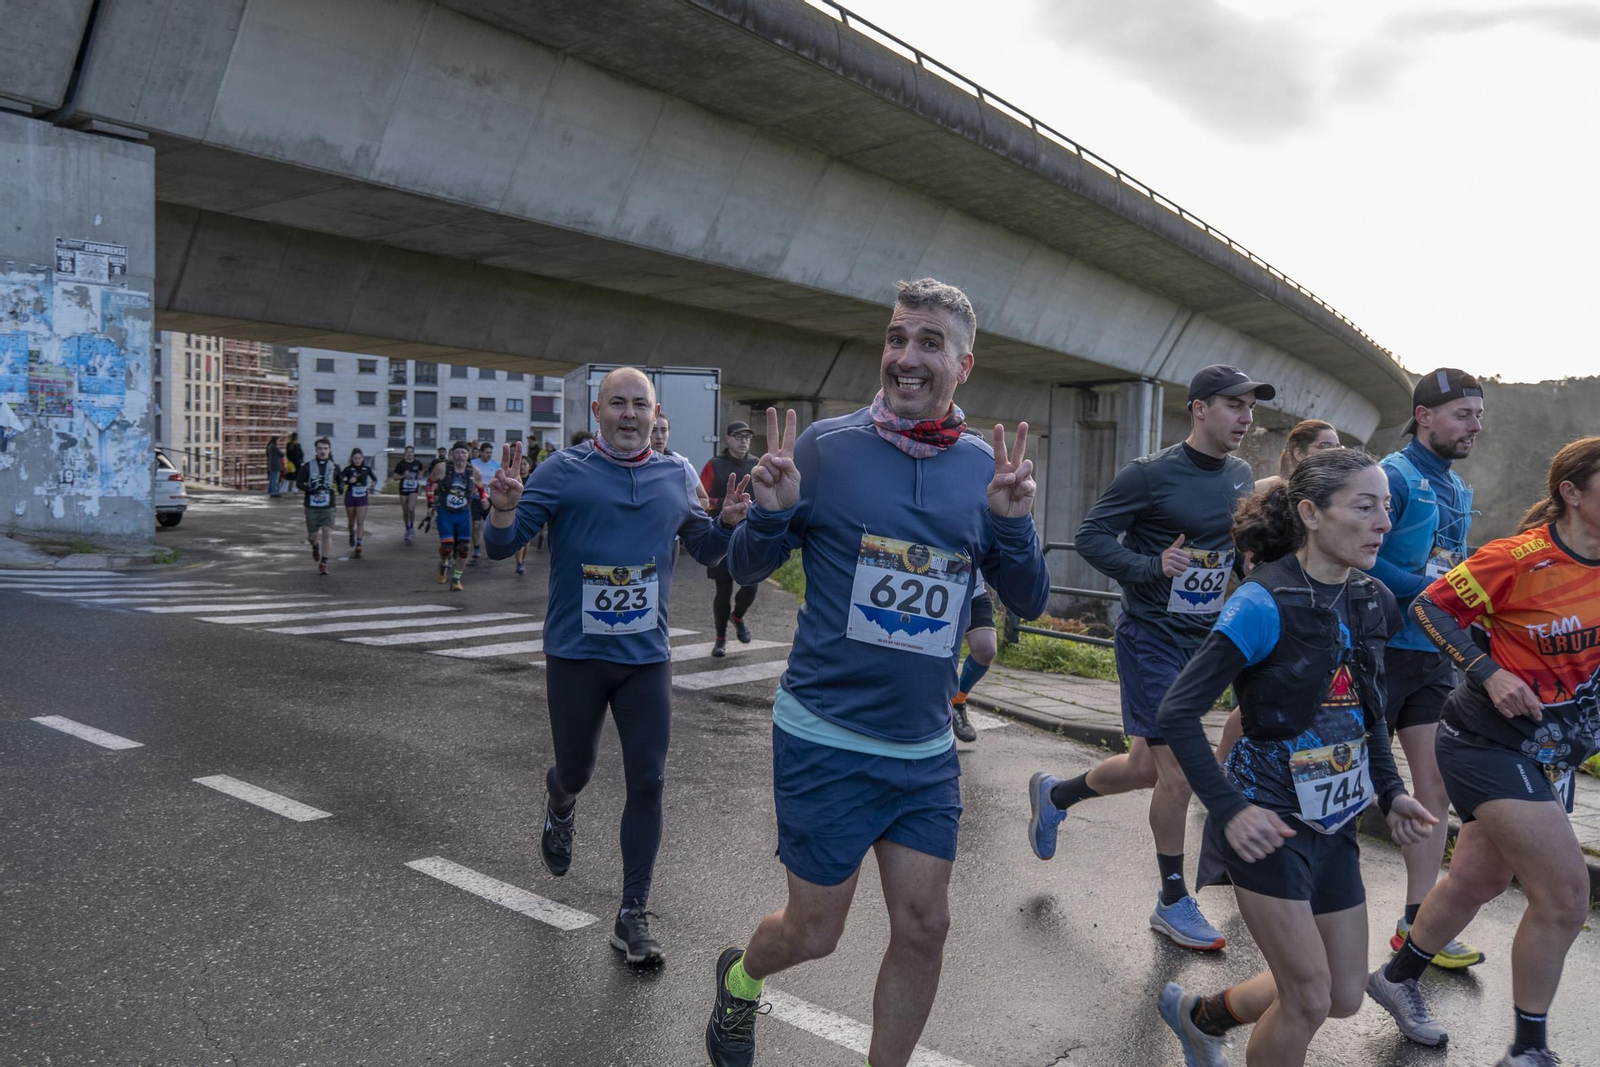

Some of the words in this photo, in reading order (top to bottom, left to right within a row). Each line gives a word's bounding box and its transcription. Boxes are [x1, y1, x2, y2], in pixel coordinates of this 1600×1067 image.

[594, 587, 648, 611] 623
[870, 574, 949, 619] 620
[1183, 571, 1225, 592] 662
[1414, 605, 1447, 646] BRUTANZOS
[1444, 643, 1466, 663] TEAM
[1525, 614, 1582, 639] TEAM
[1315, 770, 1365, 817] 744
